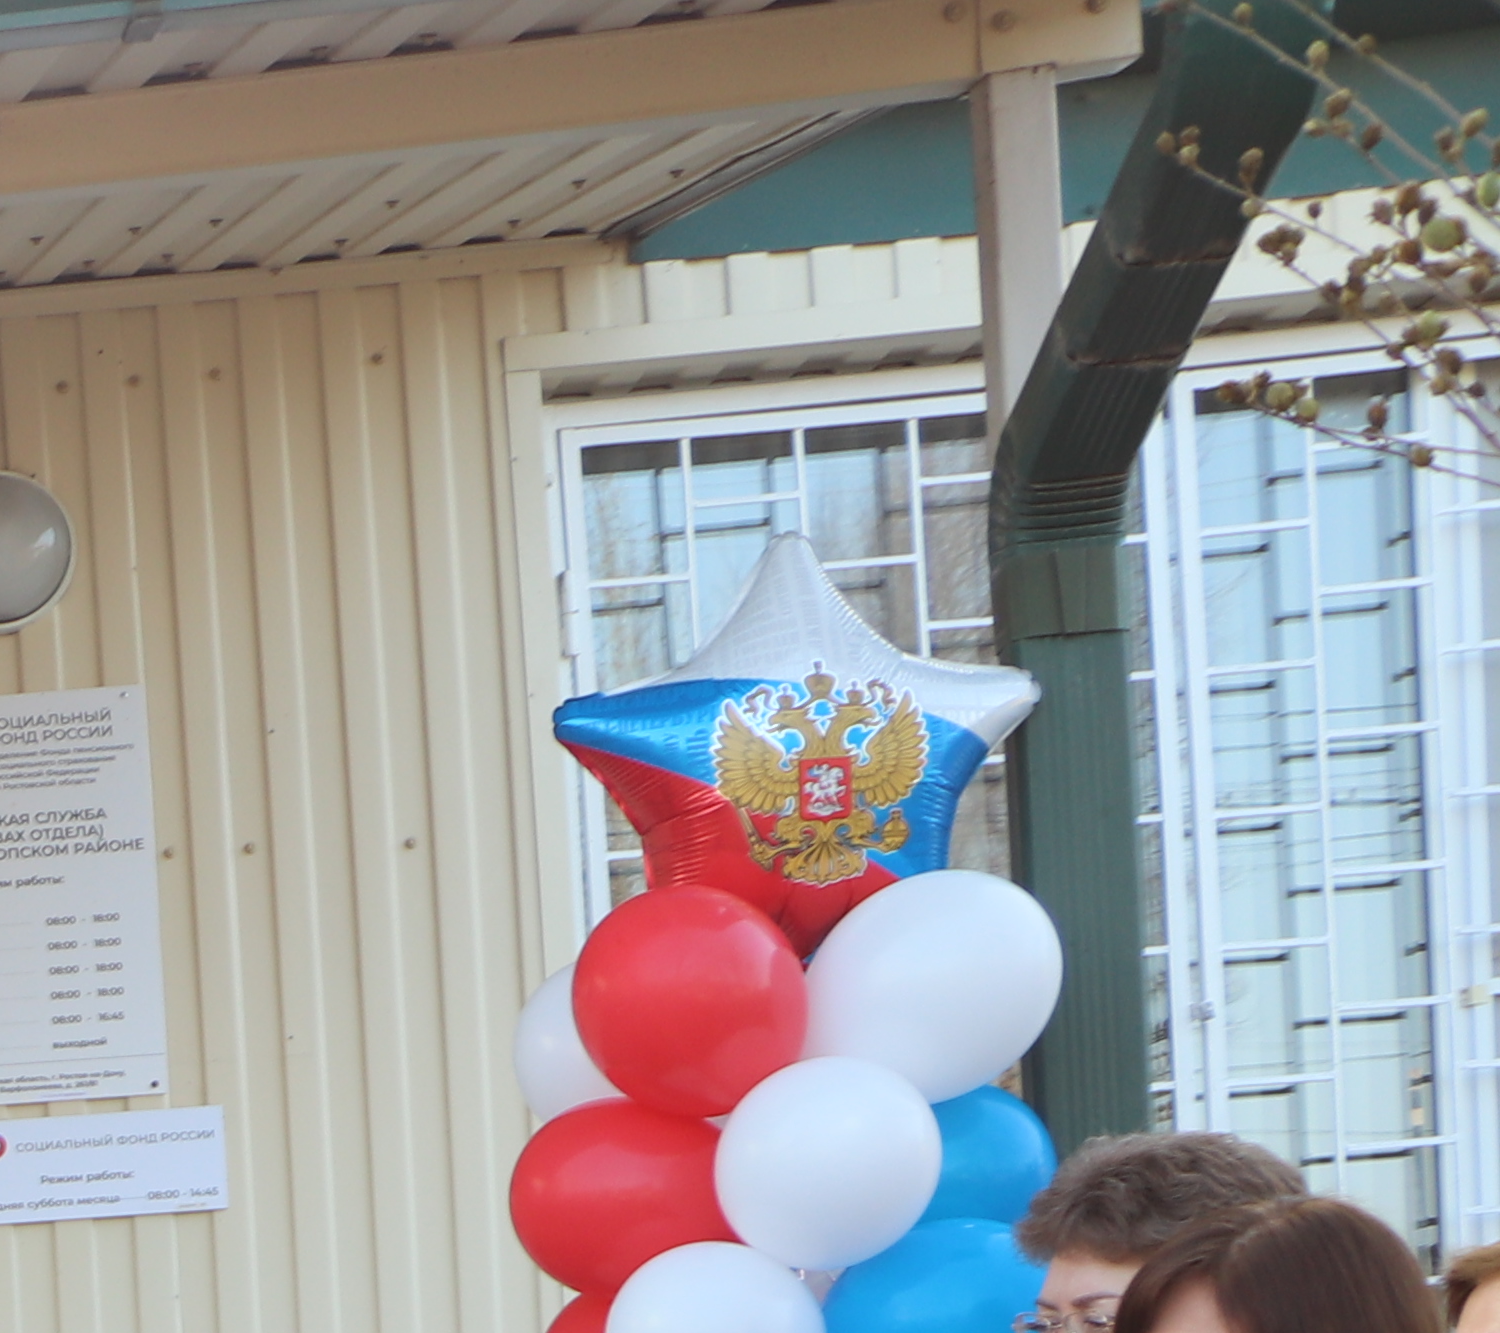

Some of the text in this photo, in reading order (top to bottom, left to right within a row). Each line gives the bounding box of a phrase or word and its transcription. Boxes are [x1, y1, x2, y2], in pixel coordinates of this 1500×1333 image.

[43, 725, 113, 742] РОССИИ
[34, 808, 107, 824] СЛУЖБА
[30, 824, 104, 843] ОТДЕЛА)
[74, 837, 146, 854] РАЙОНЕ
[15, 875, 65, 889] работы:
[15, 1129, 215, 1153] СОЦИАЛЬНЫЙ ФОНД РОССИИ
[40, 1169, 136, 1185] Режим работы:
[27, 1194, 74, 1210] суббота
[77, 1193, 121, 1206] месяца
